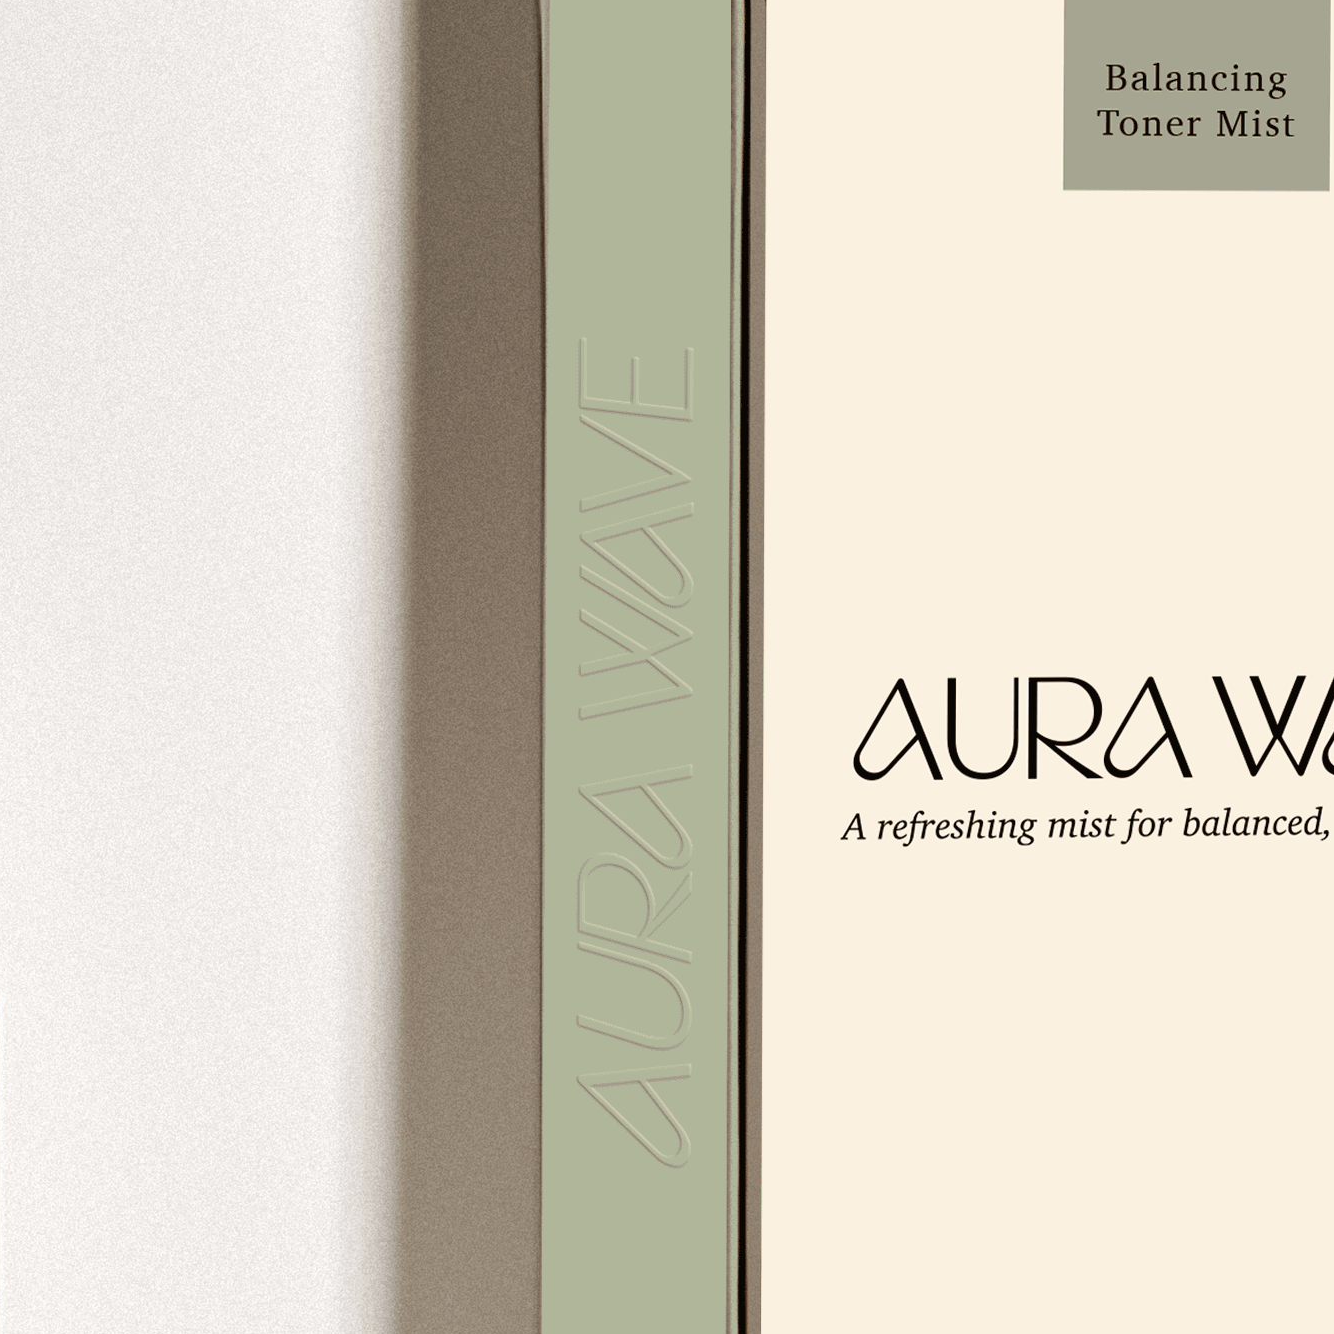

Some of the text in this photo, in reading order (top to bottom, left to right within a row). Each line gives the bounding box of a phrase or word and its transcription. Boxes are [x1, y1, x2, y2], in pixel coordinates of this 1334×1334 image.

[1105, 62, 1288, 100] Balancing
[1096, 109, 1295, 138] Toner Mist
[852, 676, 1193, 782] AURA
[576, 336, 695, 1168] AURA WAVE
[840, 812, 867, 841] A
[877, 809, 1038, 848] refreshing
[1048, 808, 1117, 841] mist
[1119, 807, 1173, 845] for
[1183, 805, 1330, 842] balanced,
